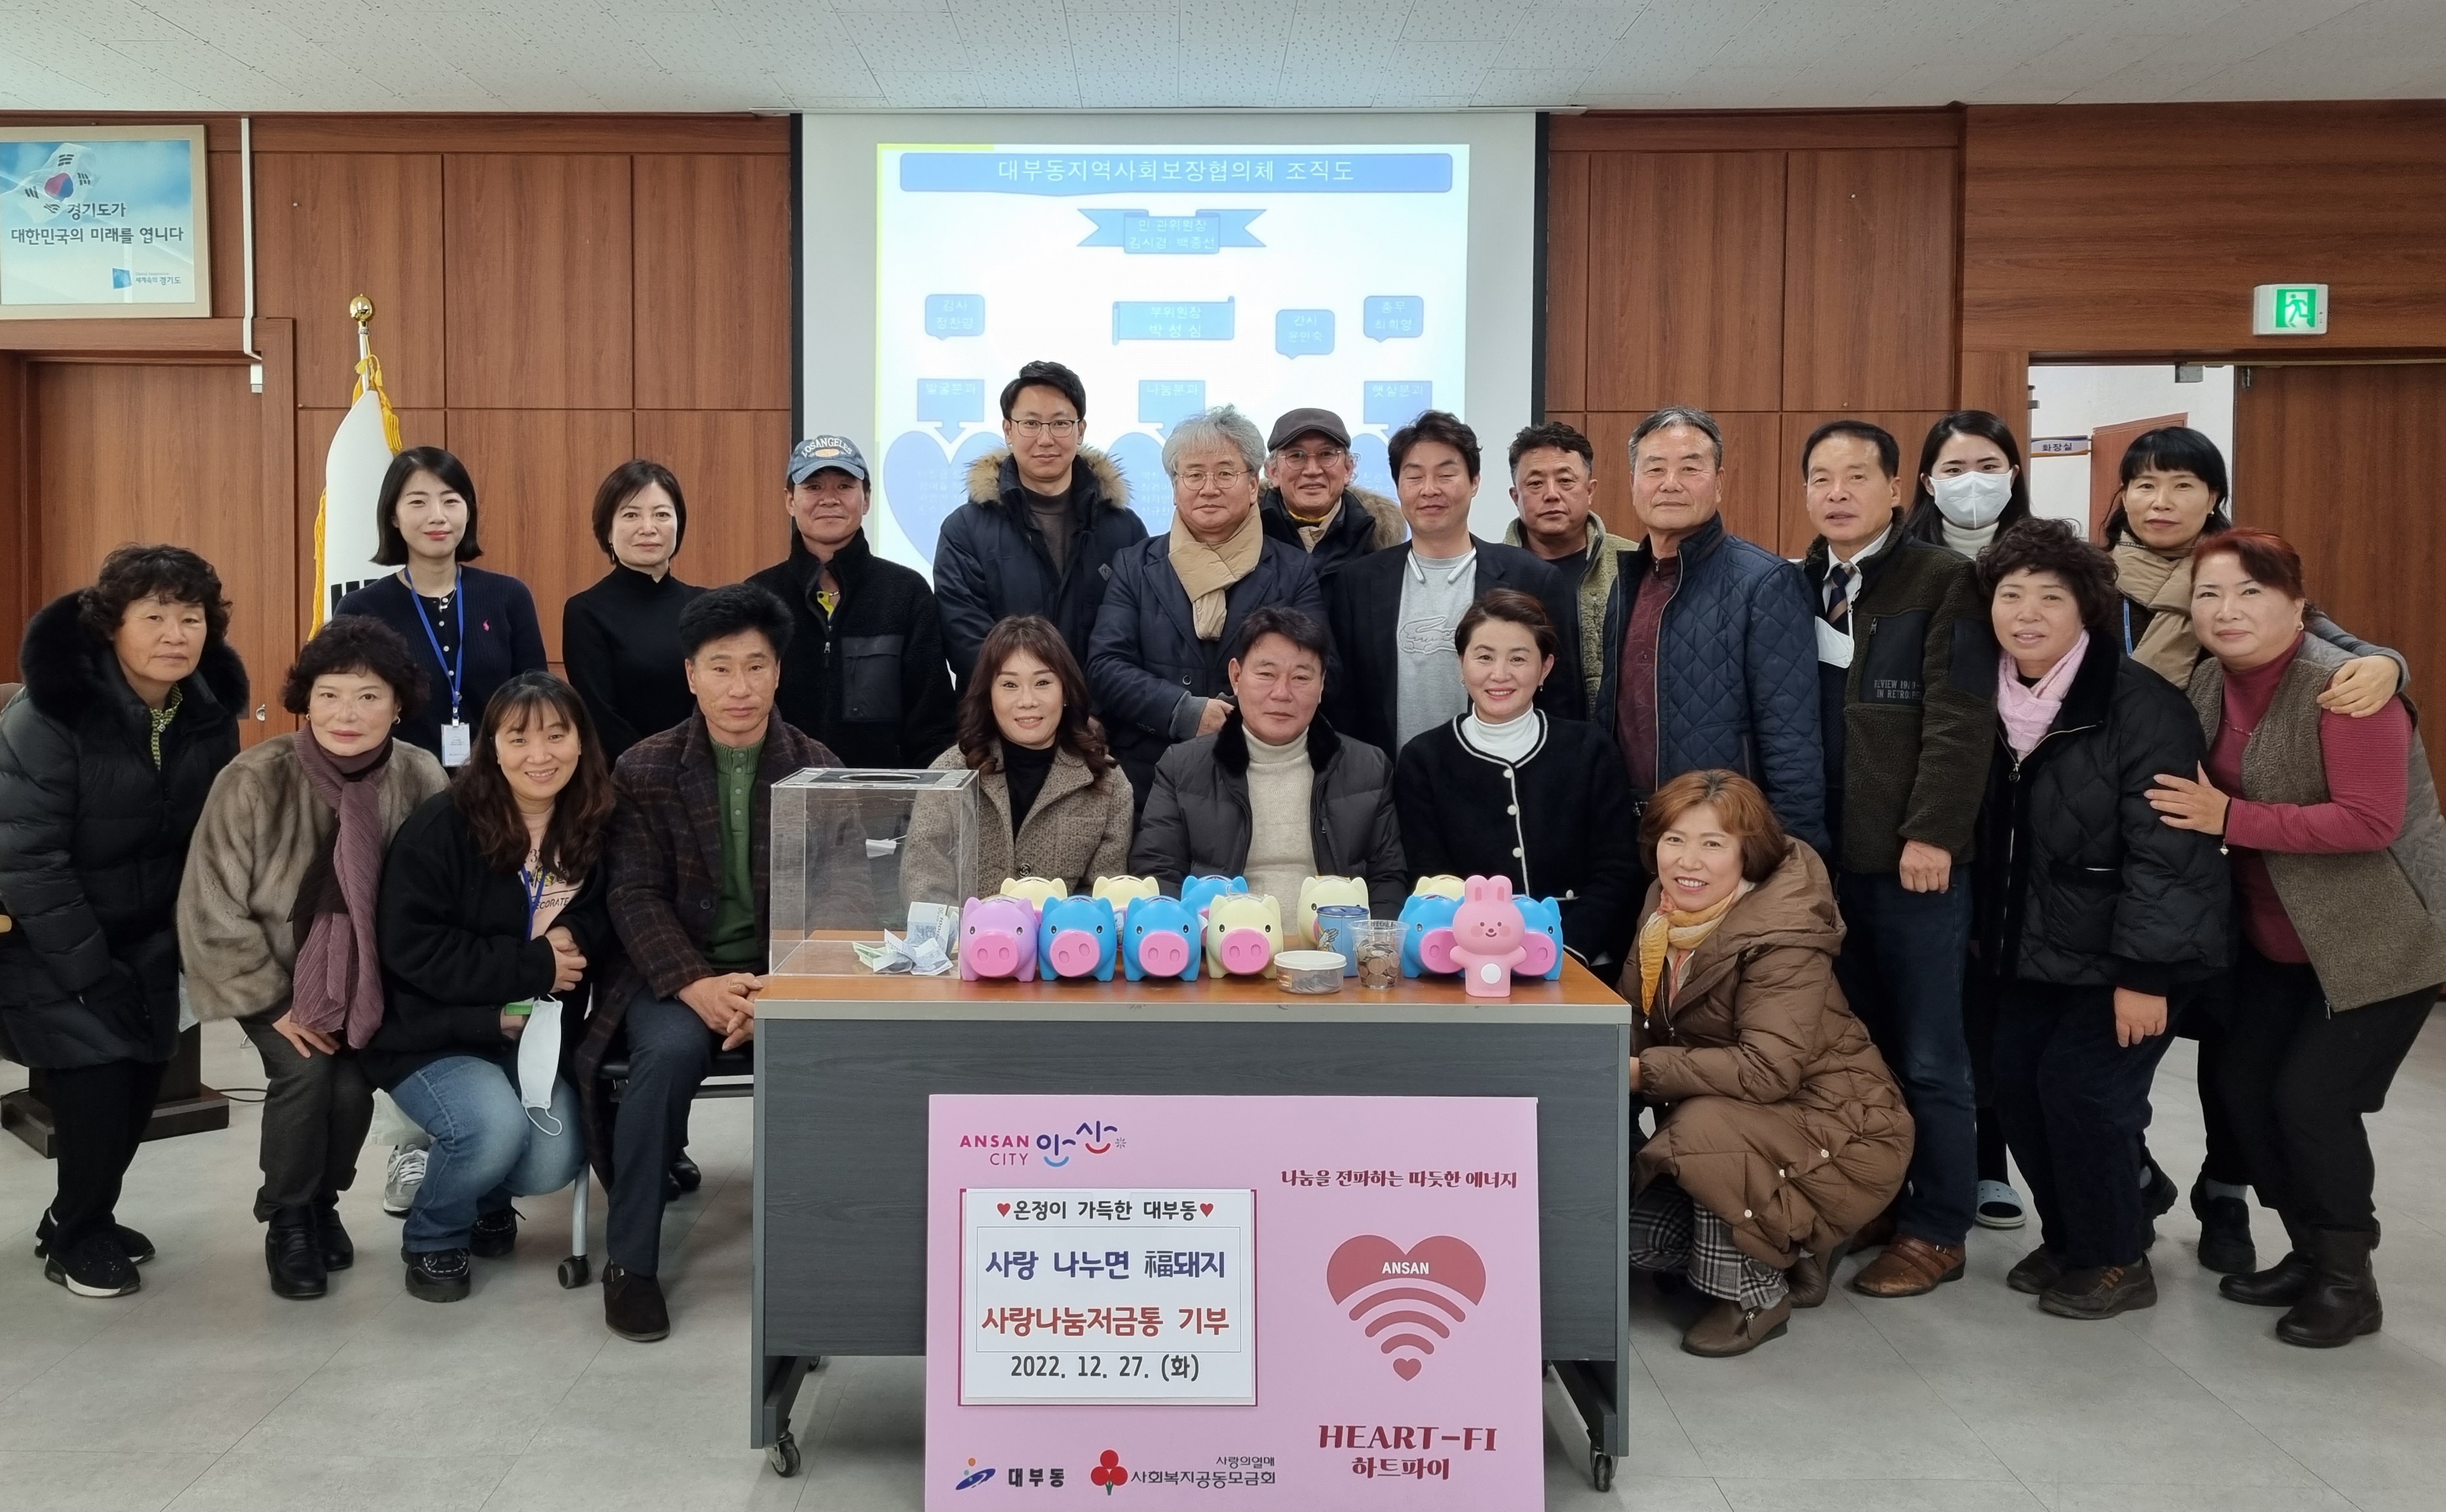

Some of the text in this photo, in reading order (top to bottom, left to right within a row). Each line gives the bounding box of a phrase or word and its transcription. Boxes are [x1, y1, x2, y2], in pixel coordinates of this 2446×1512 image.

[998, 160, 1354, 182] 대부동지역사회보장협의체 조직도
[67, 203, 126, 220] 경기도가
[11, 227, 183, 245] 대한민국의 미래를 엽니다
[159, 276, 182, 286] 경기도
[1150, 307, 1202, 319] 부위원장
[1147, 384, 1198, 396] 나눔분과
[2042, 443, 2072, 451] 화장실
[1874, 680, 1898, 689] REVIEW
[1877, 689, 1884, 698] IN
[535, 898, 569, 910] ECORATE
[959, 1135, 1029, 1148] ANSAN
[989, 1153, 1029, 1166] CITY
[1281, 1169, 1518, 1188] 나눔을 전파하는 따듯한 에너지
[1013, 1200, 1197, 1221] 온정이 가득한 대부동
[985, 1250, 1225, 1279] 사랑 나누면 福돼지
[1382, 1262, 1429, 1274] ANSAN
[982, 1307, 1229, 1336] 사랑나눔저금통 기부
[1011, 1354, 1199, 1382] 2022. 12. 27. (화)
[1319, 1425, 1497, 1451] HEART-FI
[1215, 1456, 1275, 1469] 사랑의열매
[1352, 1456, 1449, 1480] 하트파이
[1008, 1467, 1065, 1487] 대부동
[1131, 1471, 1276, 1488] 사회복지공동모금회
